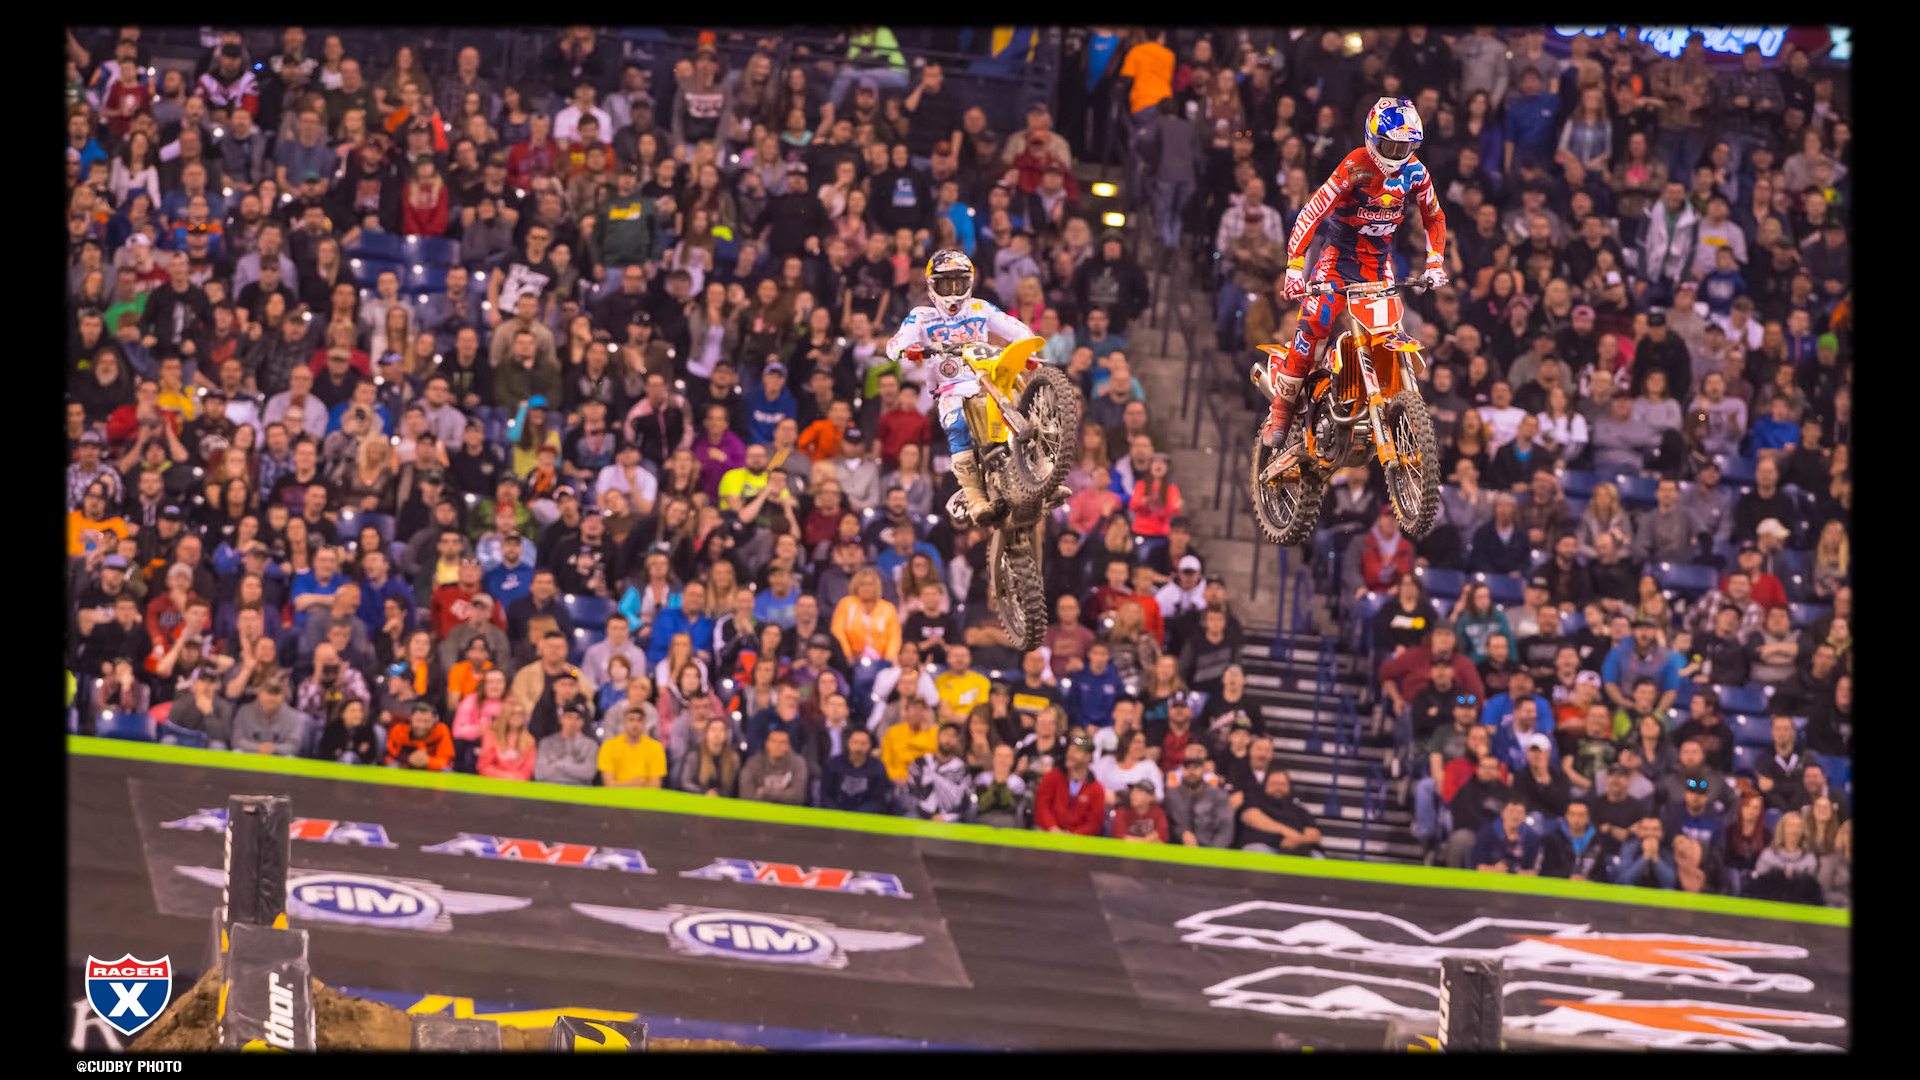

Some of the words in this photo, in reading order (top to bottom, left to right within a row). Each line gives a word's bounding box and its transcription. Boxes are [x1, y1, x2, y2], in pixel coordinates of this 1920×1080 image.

[1357, 207, 1382, 221] Red
[1358, 222, 1398, 236] KTM
[1365, 298, 1388, 327] 1
[932, 320, 984, 342] FOX
[420, 832, 658, 875] AMA
[679, 857, 914, 900] AMA
[299, 884, 419, 915] FIM
[696, 922, 813, 952] FIM
[263, 971, 294, 1049] thor.
